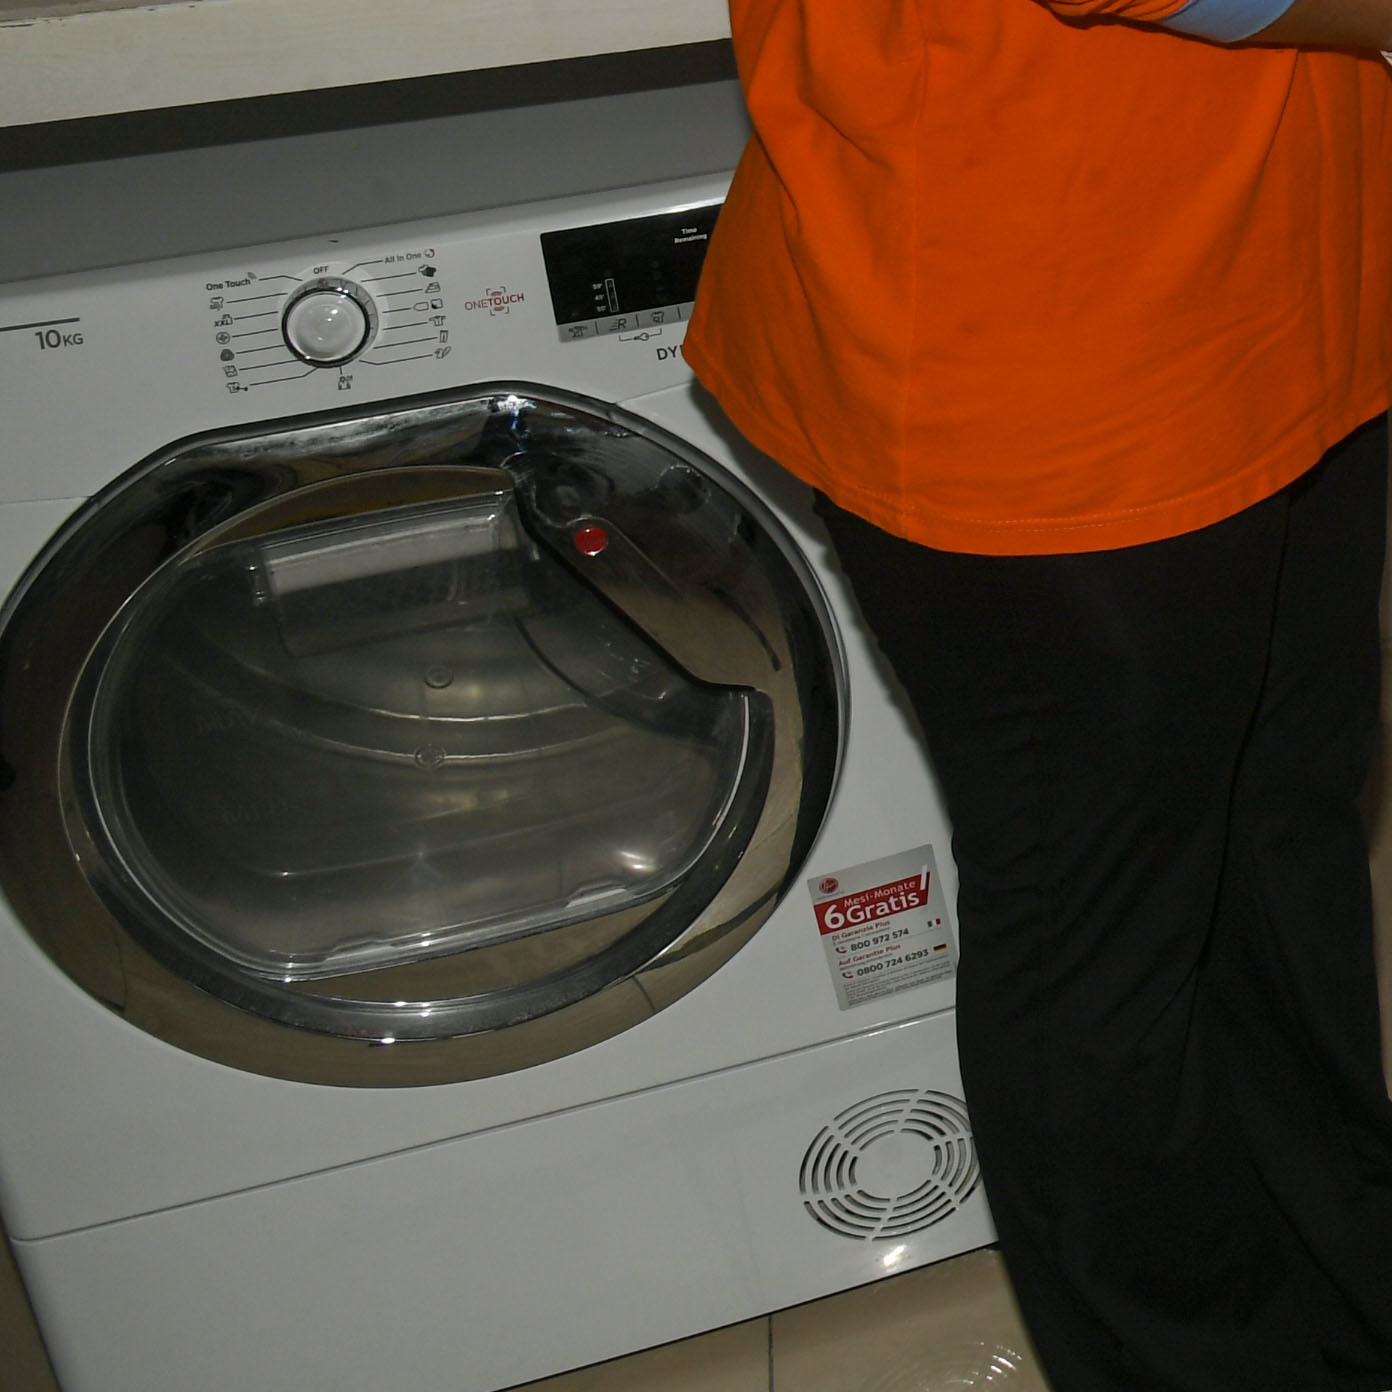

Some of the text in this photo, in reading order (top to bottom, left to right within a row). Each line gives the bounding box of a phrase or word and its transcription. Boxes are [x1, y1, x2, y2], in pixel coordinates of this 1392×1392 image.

[384, 256, 395, 265] All
[405, 252, 422, 261] One
[312, 265, 329, 275] OFF
[205, 277, 251, 291] One Touch
[656, 344, 684, 360] DY
[824, 904, 846, 930] 6
[844, 880, 916, 908] Mesi-Monate
[846, 892, 920, 924] Gratis
[851, 940, 871, 952] 800
[872, 933, 890, 945] 972
[892, 927, 910, 940] 574
[856, 962, 884, 977] 0800
[885, 956, 904, 969] 724
[904, 948, 929, 962] 6293
